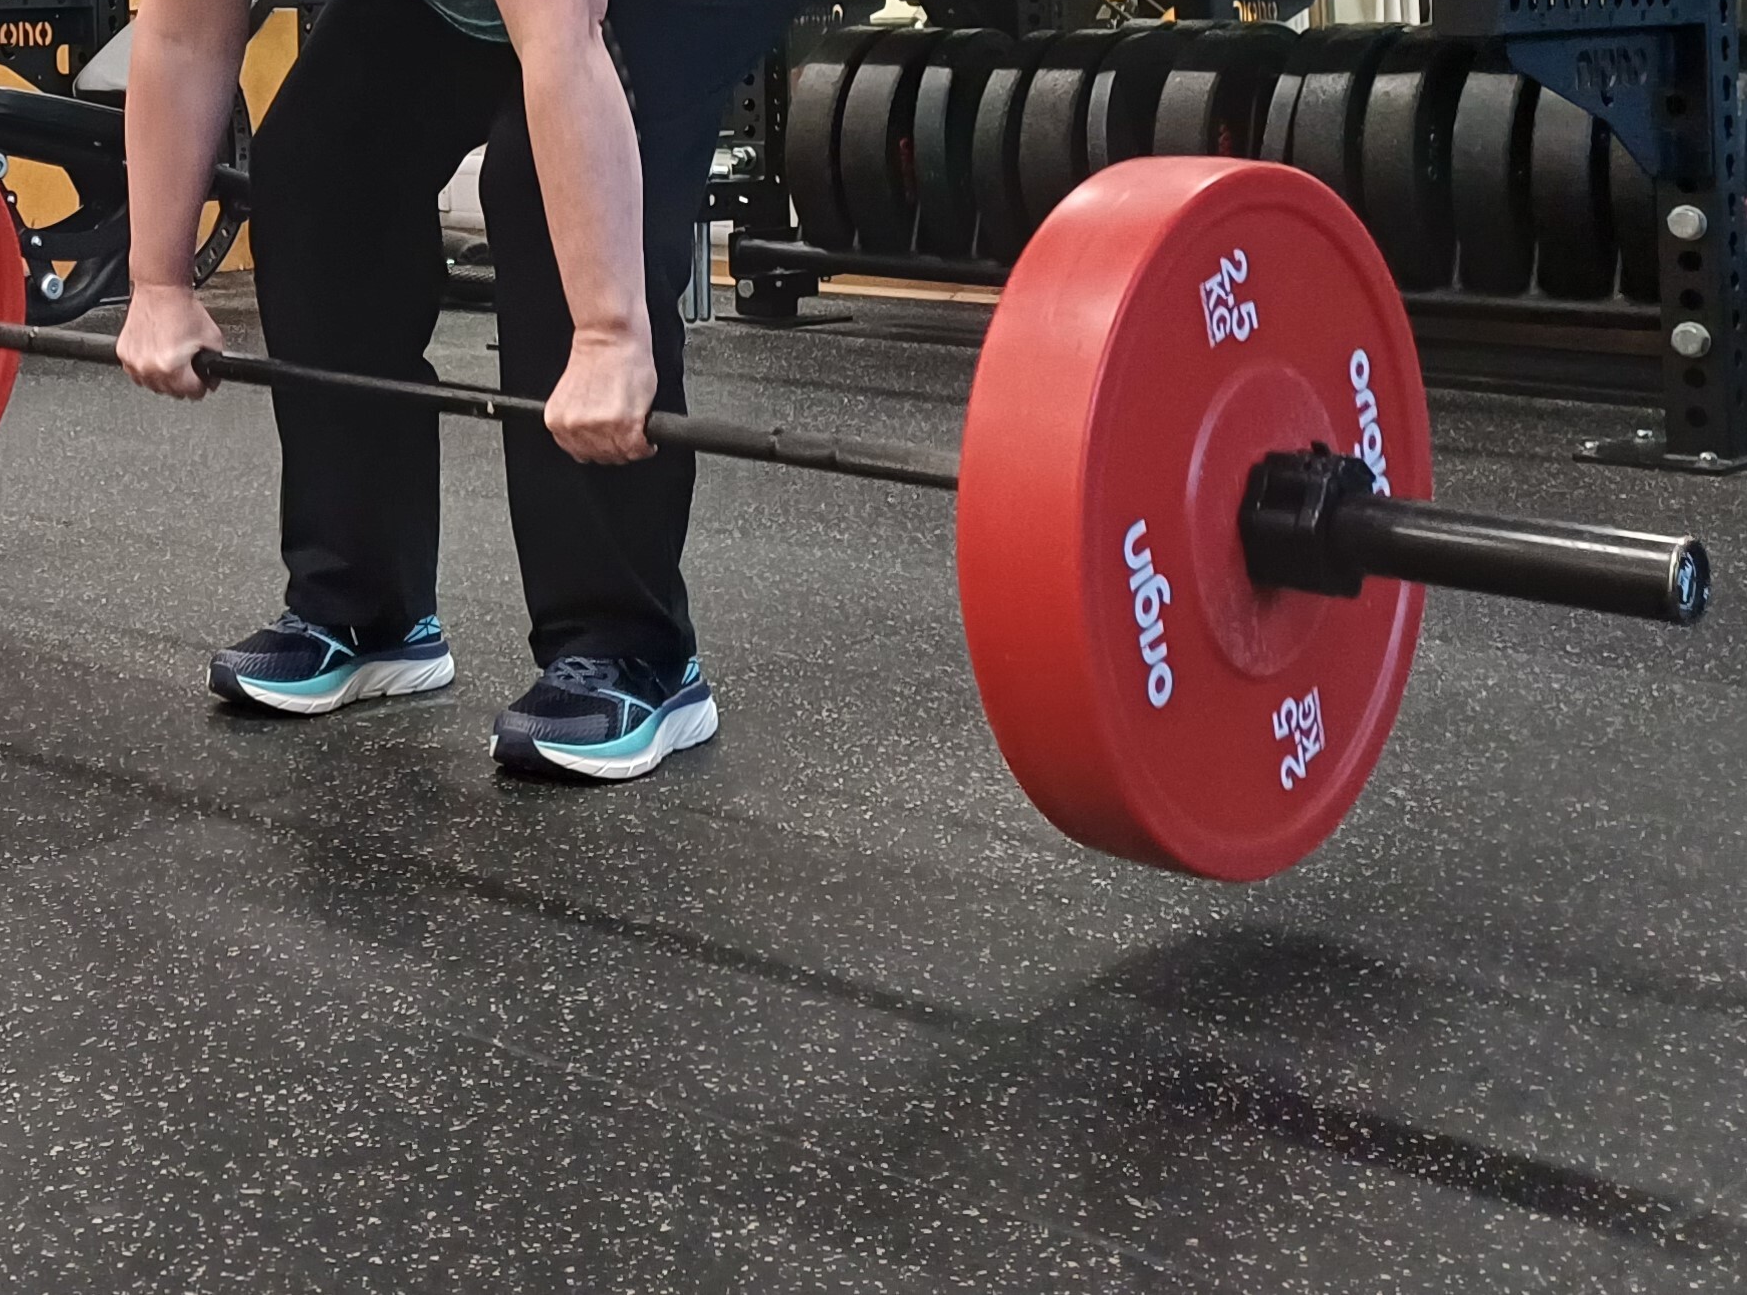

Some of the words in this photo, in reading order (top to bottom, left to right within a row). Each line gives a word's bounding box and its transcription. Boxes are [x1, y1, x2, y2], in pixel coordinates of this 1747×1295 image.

[1204, 273, 1231, 344] KG
[1220, 248, 1258, 341] 2.5
[1124, 519, 1173, 709] origin
[1272, 697, 1306, 791] 2.5
[1299, 692, 1321, 763] KG
